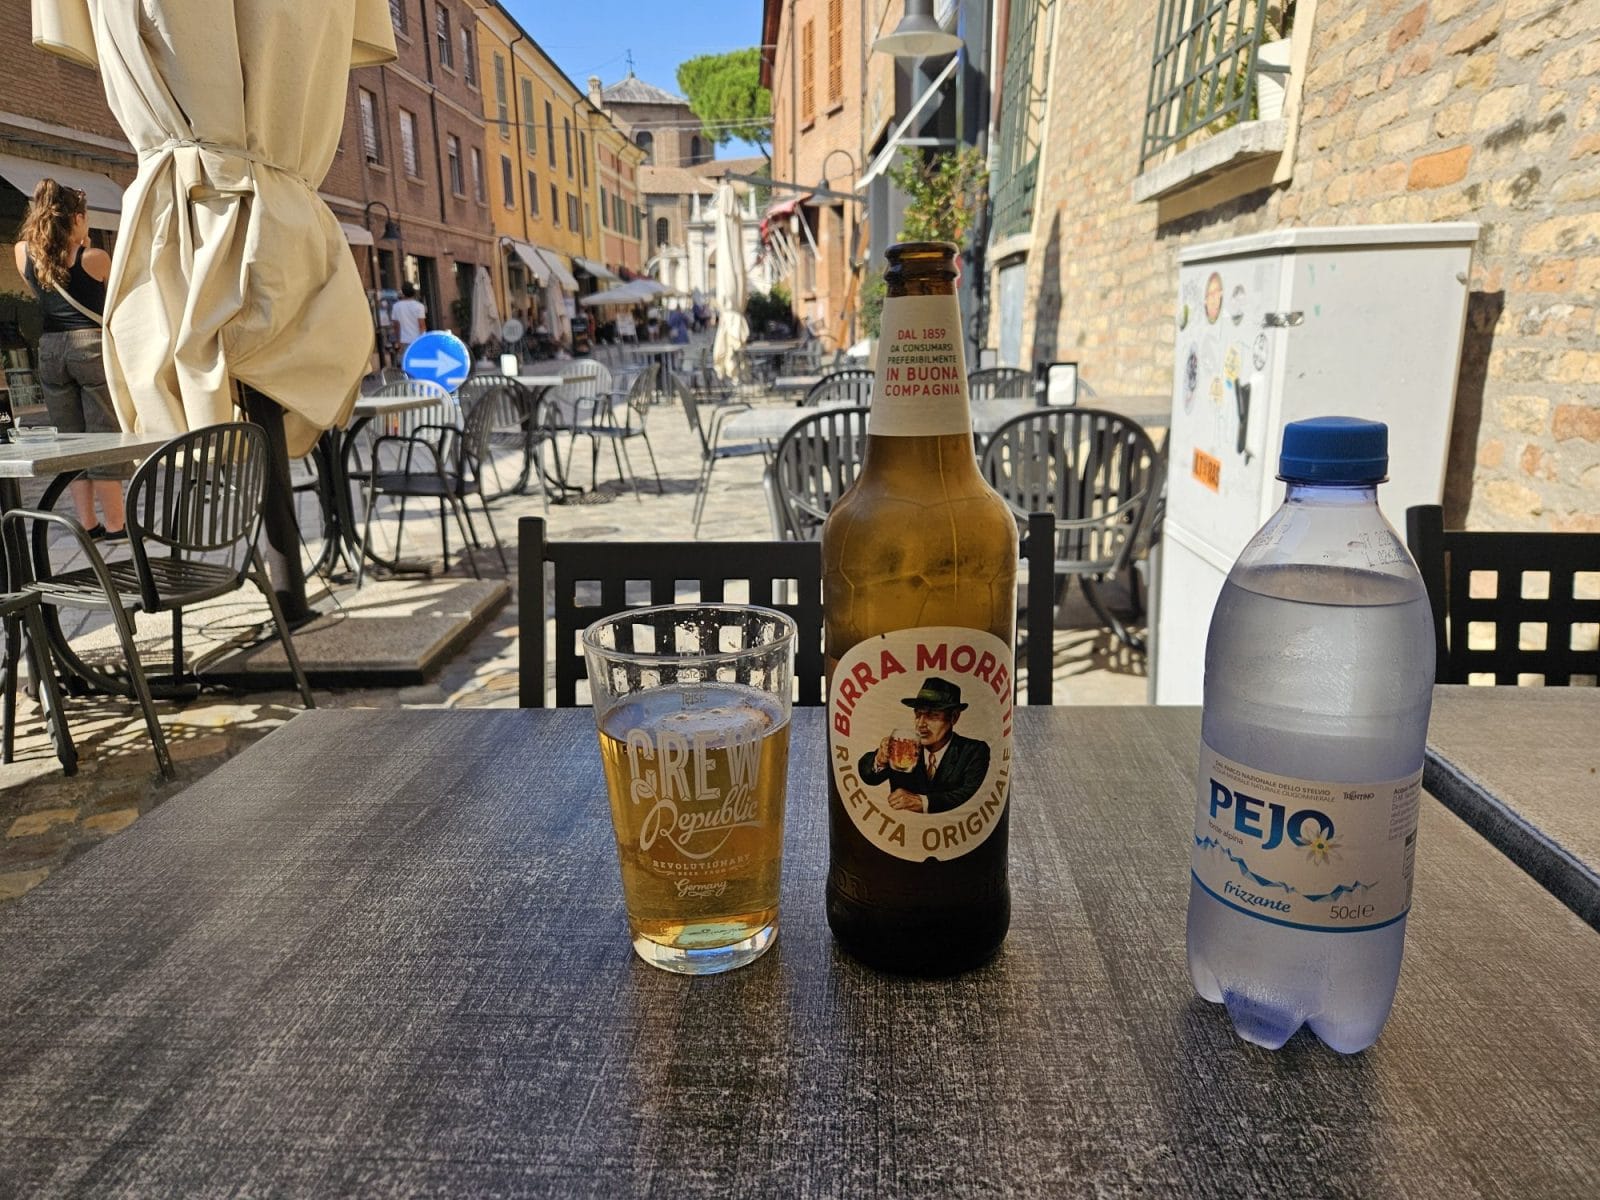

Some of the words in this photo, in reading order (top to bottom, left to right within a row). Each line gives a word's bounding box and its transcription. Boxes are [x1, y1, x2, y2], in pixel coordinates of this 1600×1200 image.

[898, 329, 917, 340] DAL
[922, 328, 946, 339] 1859
[890, 344, 900, 353] DA
[902, 343, 953, 353] CONSUMARSI
[887, 355, 957, 364] PREFERIBILMENTE
[886, 367, 899, 381] IN
[907, 366, 959, 381] BUONA
[885, 384, 960, 396] COMPAGNIA
[834, 650, 906, 737] BIRRA
[916, 643, 1012, 738] MORETTI
[627, 720, 765, 805] CREW
[1241, 772, 1277, 788] NAZIONALE
[1278, 783, 1301, 793] DELLO
[1302, 787, 1331, 796] STELVIO
[836, 744, 905, 847] RICETTA
[922, 747, 1011, 851] ORIGINALE
[640, 784, 759, 851] Republic
[1210, 777, 1335, 851] PEJO
[653, 854, 750, 870] REVOLUTIONARY
[674, 878, 728, 898] Germany
[1223, 880, 1293, 914] frizzante
